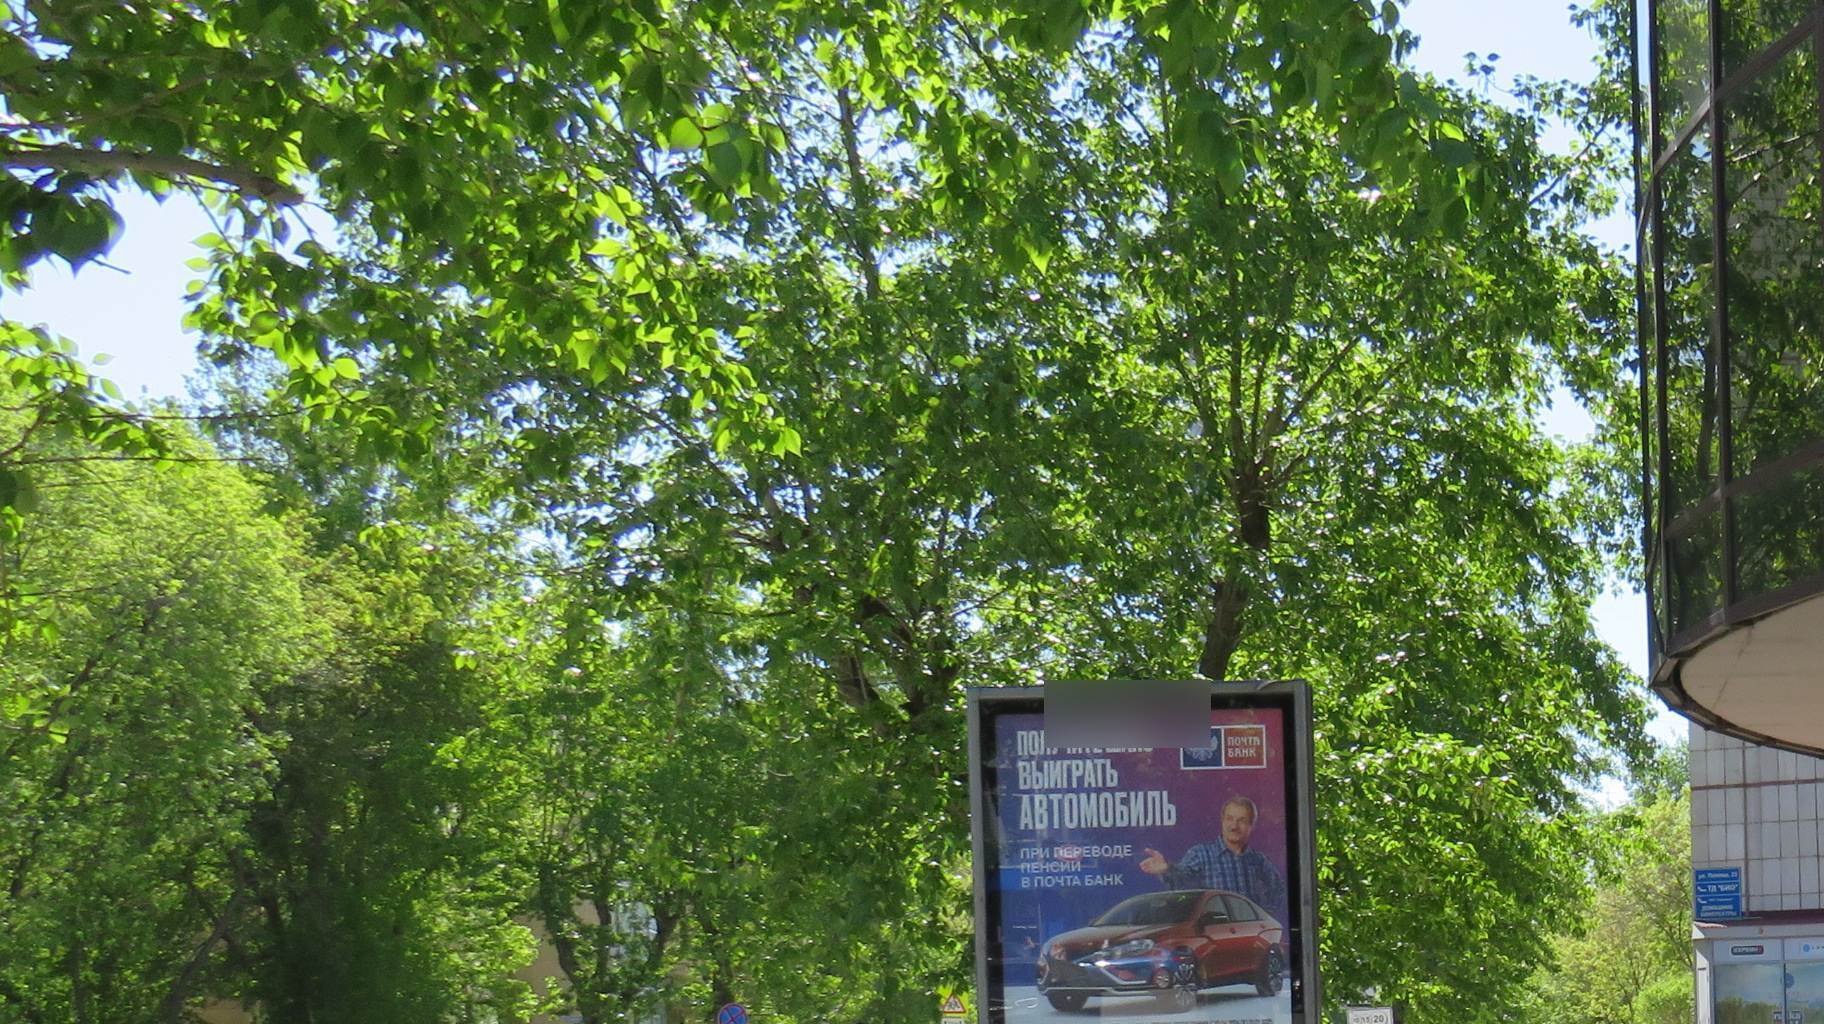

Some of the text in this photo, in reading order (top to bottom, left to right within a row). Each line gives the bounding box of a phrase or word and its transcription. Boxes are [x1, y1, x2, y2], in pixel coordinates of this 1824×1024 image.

[1227, 735, 1261, 747] ПОЧТА
[1227, 747, 1257, 758] БАНК
[1017, 758, 1120, 790] ВЫИГРАТЬ
[1018, 790, 1177, 831] АВТОМОБИЛЬ
[1020, 845, 1133, 859] ПРИ ПЕРЕВОДЕ
[1020, 861, 1081, 874] ПЕНСИИ
[1021, 874, 1124, 888] В ПОЧТА БАНК
